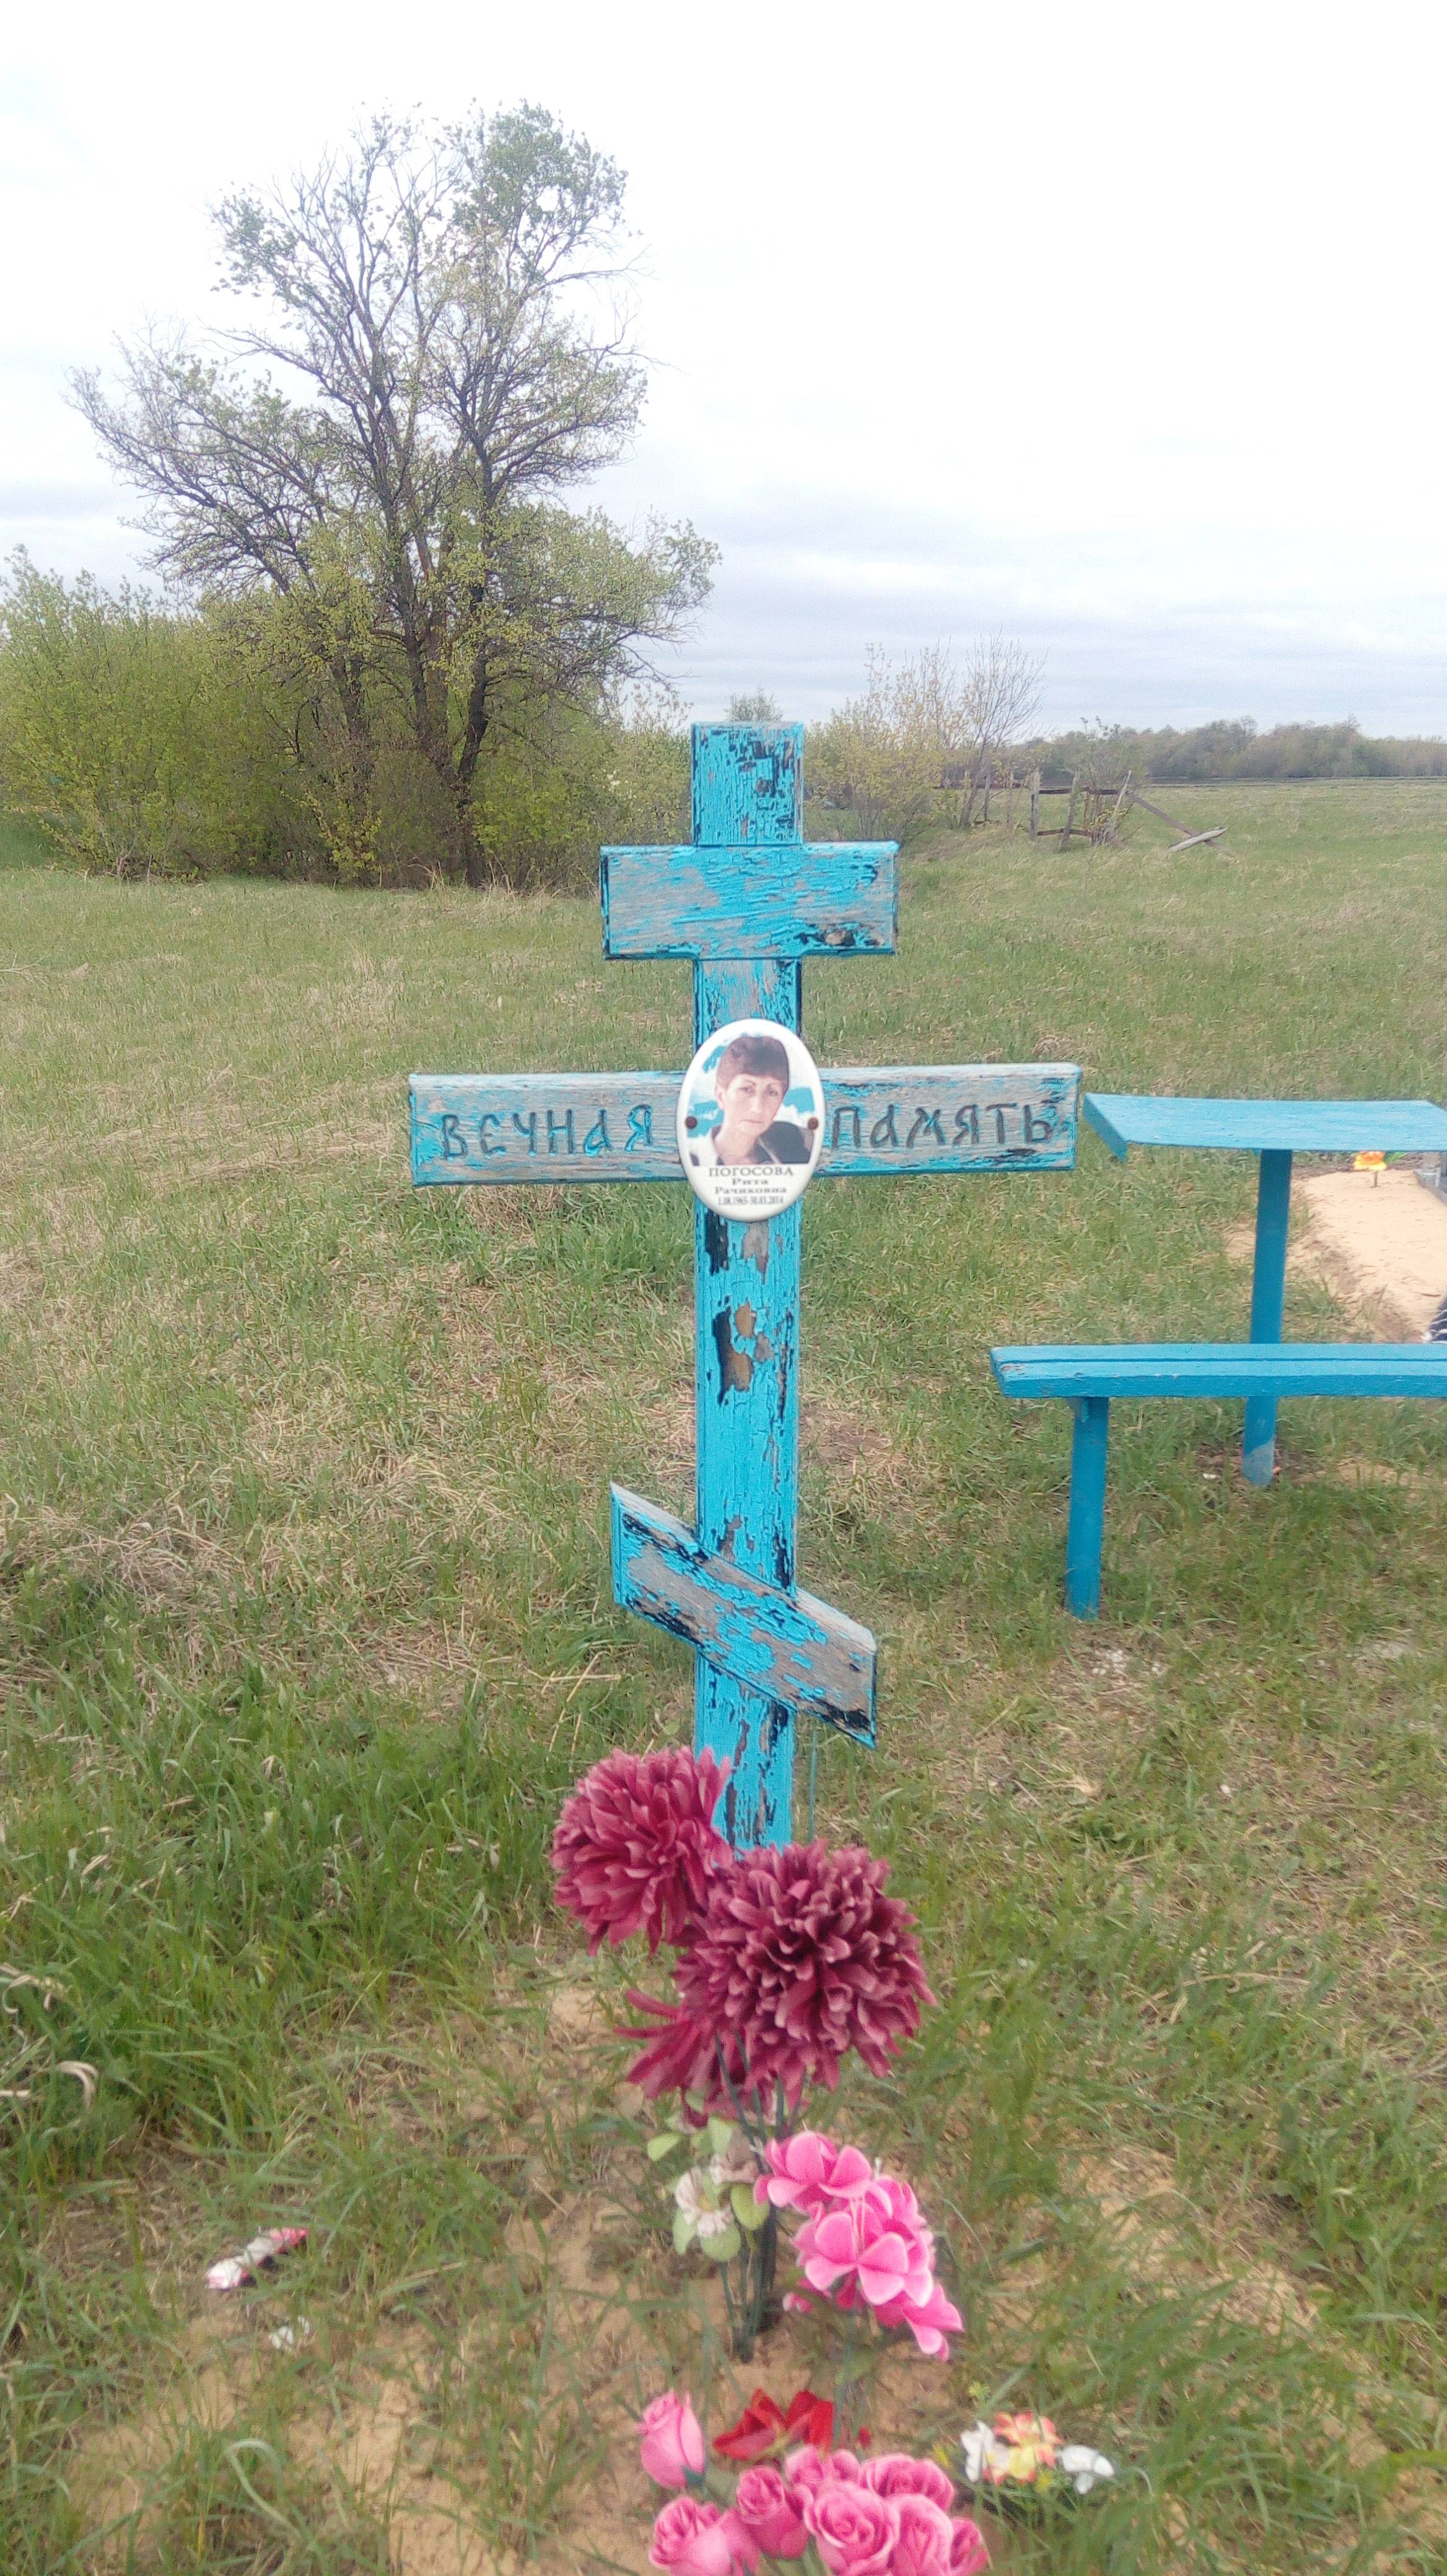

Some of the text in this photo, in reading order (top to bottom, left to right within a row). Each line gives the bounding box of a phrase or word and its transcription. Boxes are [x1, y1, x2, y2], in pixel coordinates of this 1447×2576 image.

[441, 1103, 1054, 1160] ВЕЧНАЯ ПАМЯТЬ
[709, 1167, 793, 1177] ПОГОСОВА
